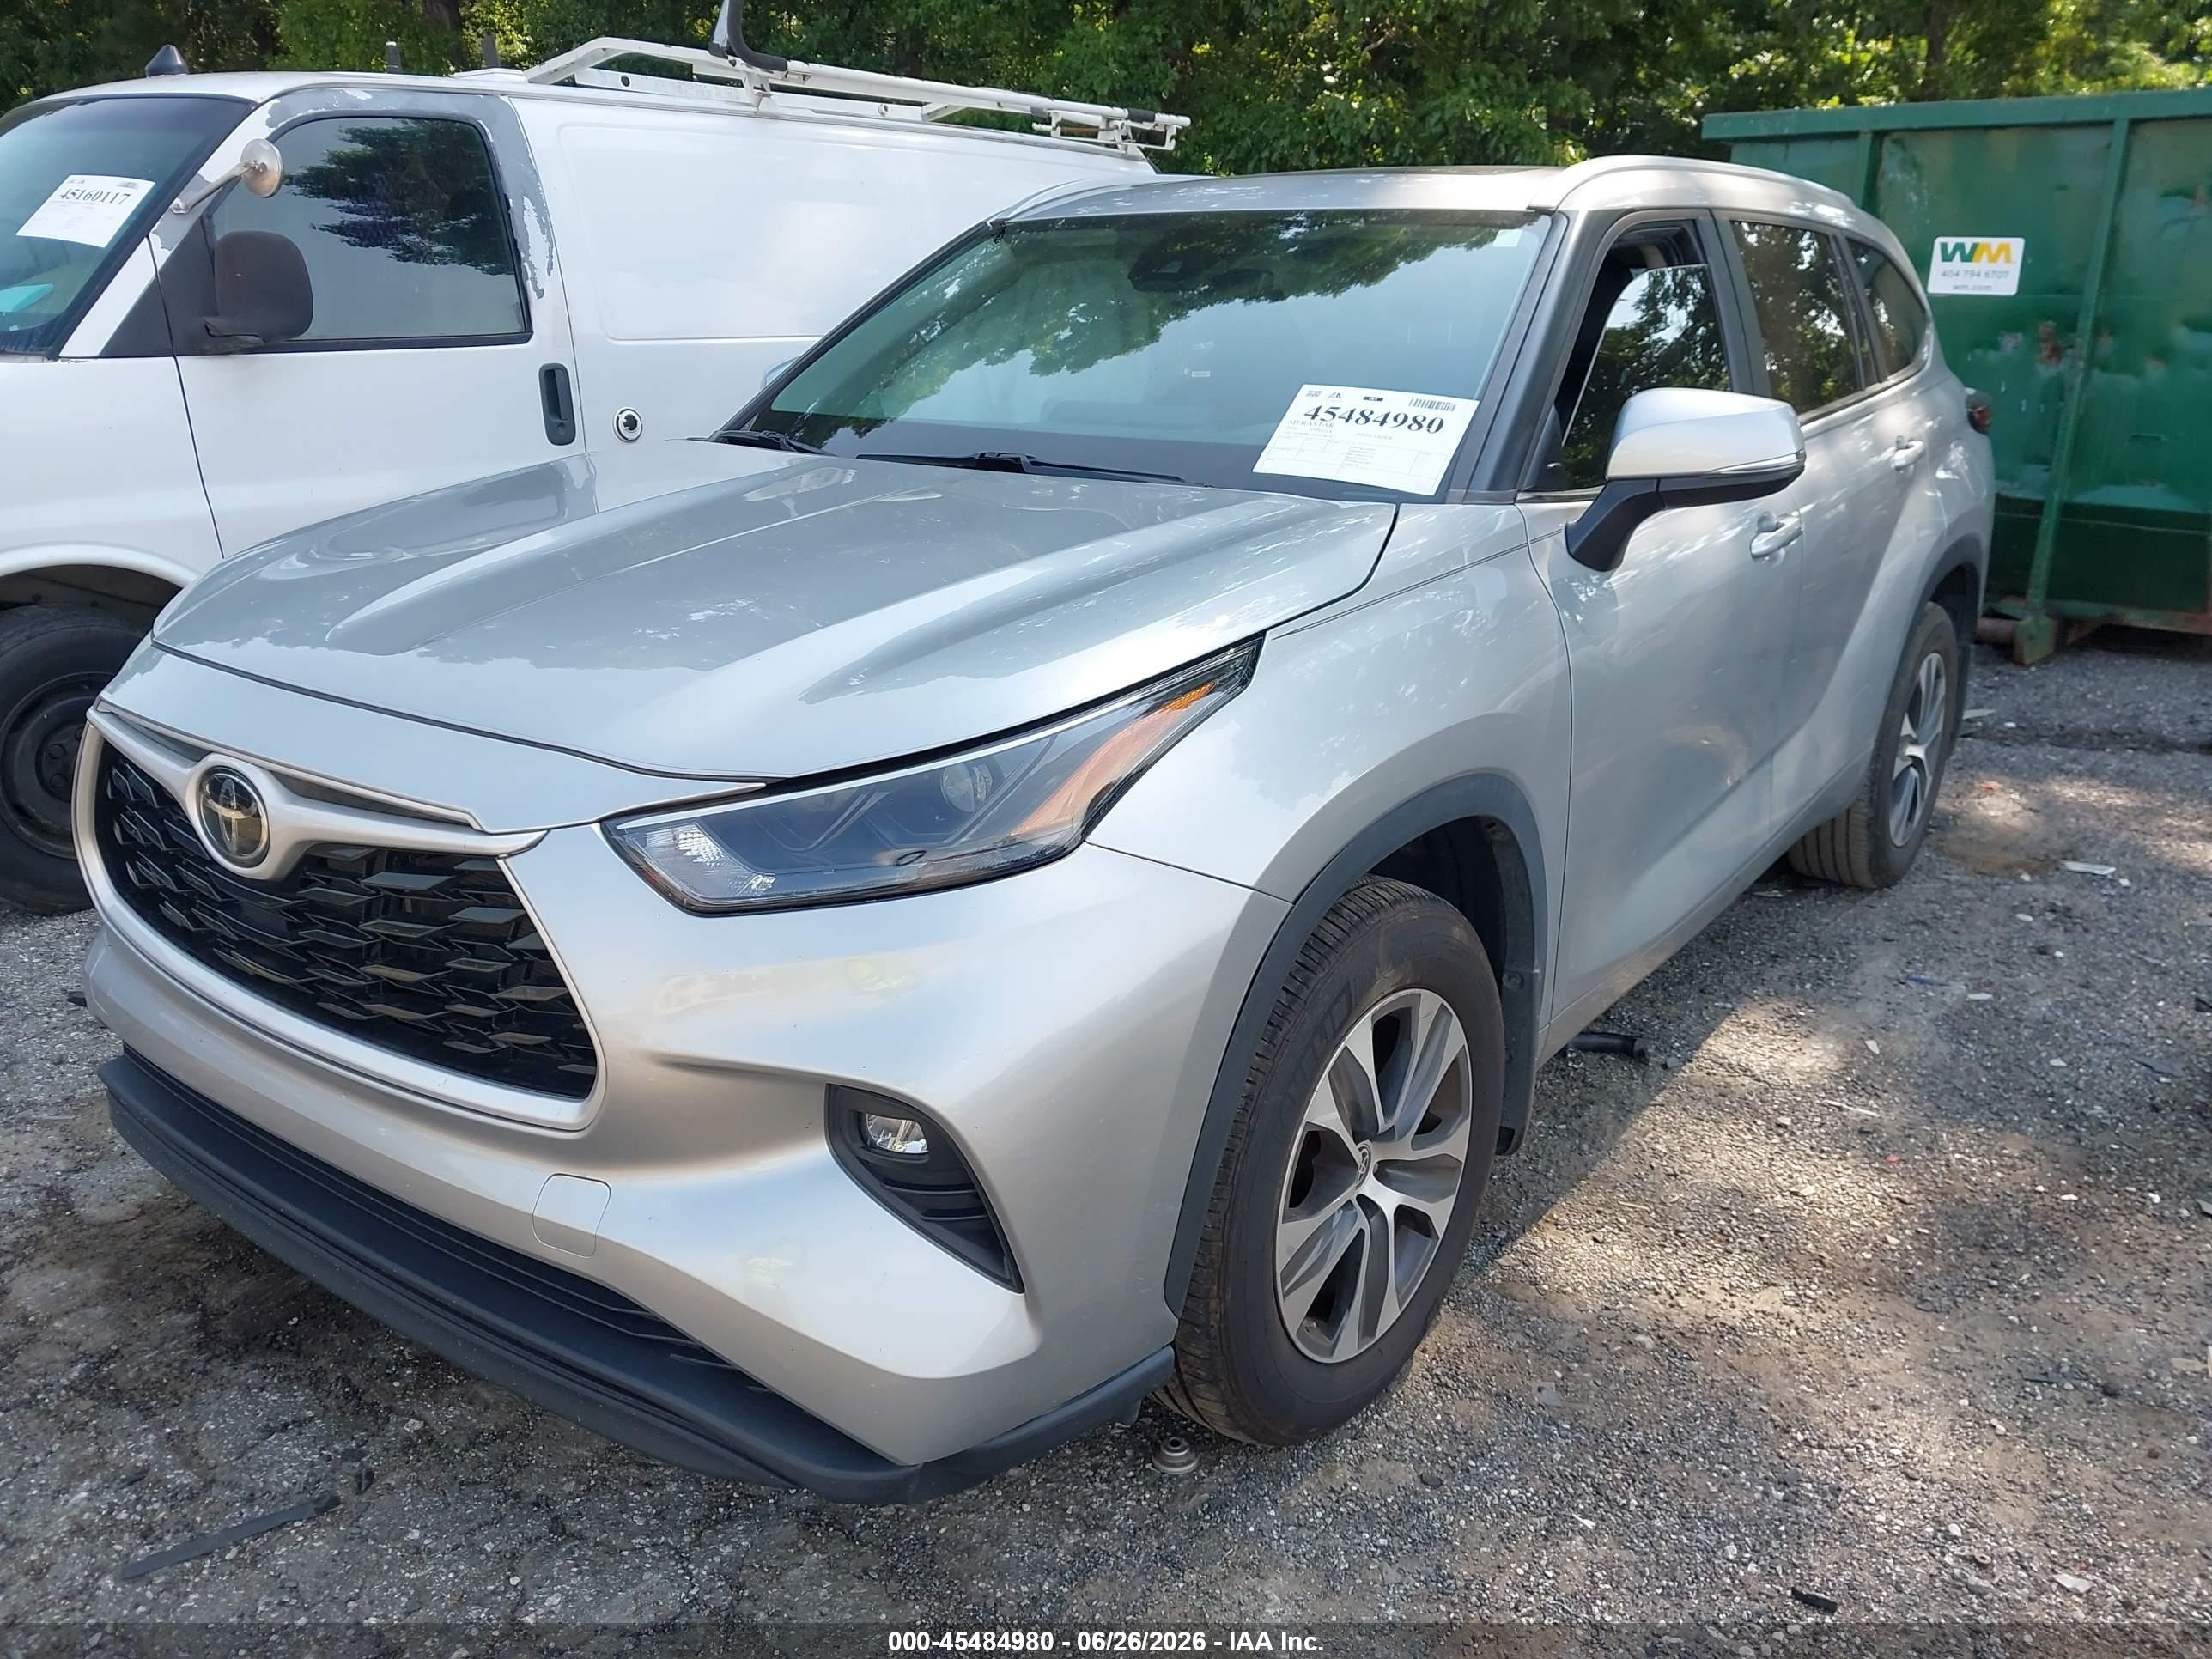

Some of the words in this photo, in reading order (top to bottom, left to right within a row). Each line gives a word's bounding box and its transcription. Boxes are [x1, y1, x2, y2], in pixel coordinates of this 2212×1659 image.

[60, 188, 131, 205] 45160117
[1940, 242, 2012, 263] WM
[1304, 404, 1444, 433] 45484980
